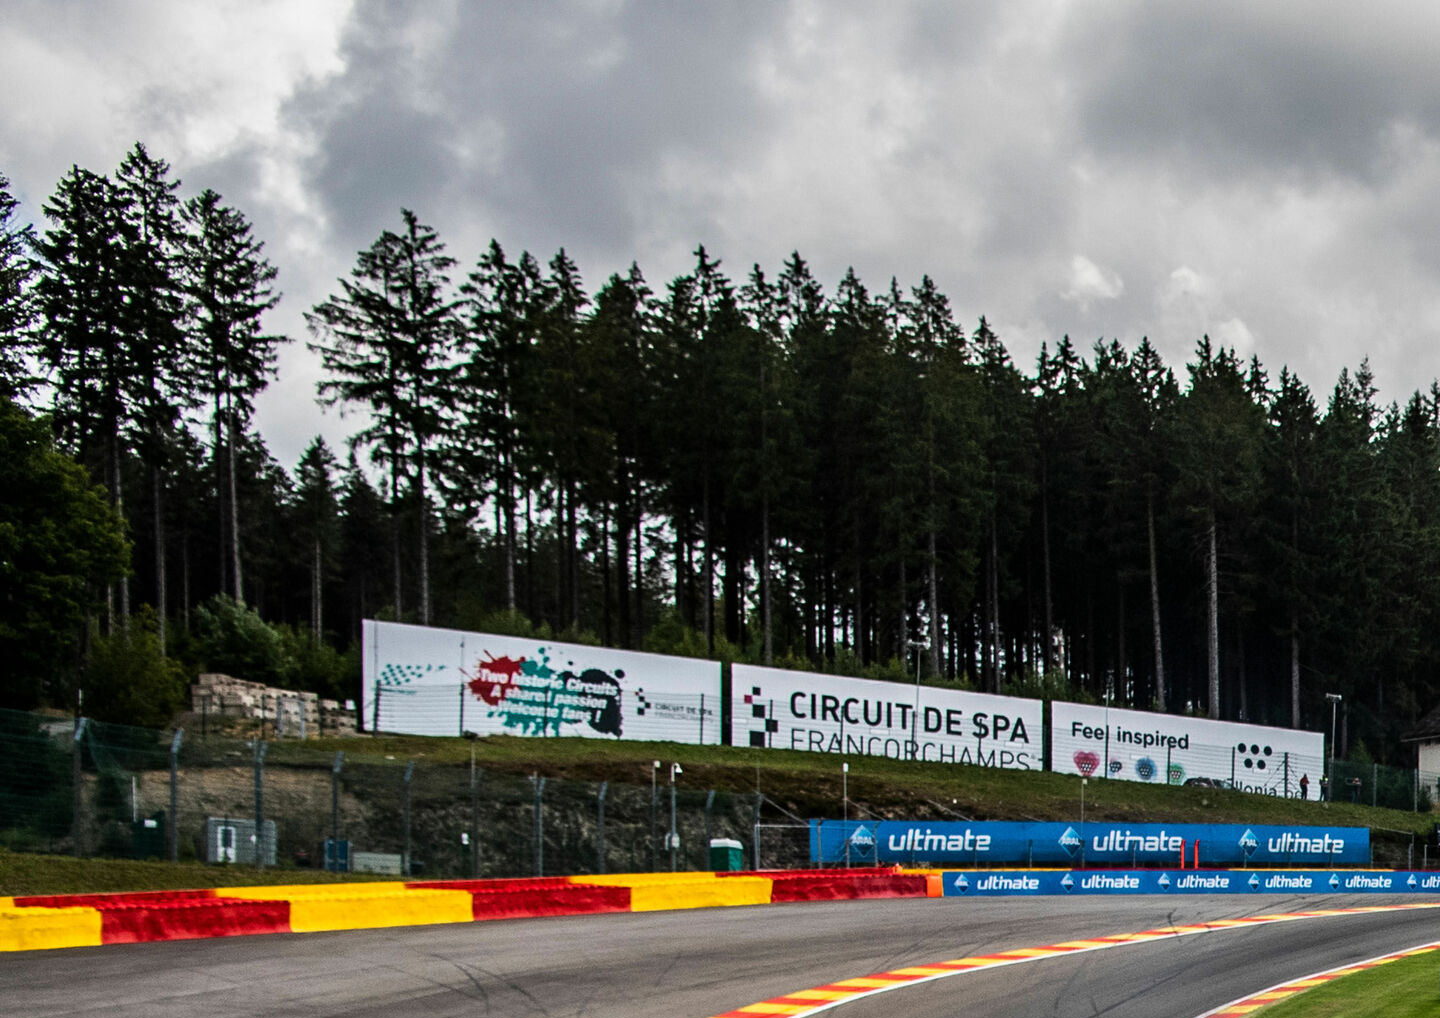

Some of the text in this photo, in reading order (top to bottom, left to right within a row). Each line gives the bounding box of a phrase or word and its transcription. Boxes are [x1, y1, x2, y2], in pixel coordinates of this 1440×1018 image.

[481, 669, 618, 696] Two historic Circuits
[490, 684, 502, 697] A
[554, 694, 608, 709] passion
[790, 691, 1030, 744] CIRCUIT DE SPA
[1117, 726, 1190, 750] inspired
[888, 829, 991, 851] ultimate
[1093, 830, 1183, 852] ultimate
[1268, 832, 1345, 853] ultimate
[977, 875, 1039, 890] ultimate
[1081, 875, 1140, 889] ultimate
[1177, 875, 1230, 889] ultimate
[1265, 875, 1313, 888] ultimate
[1345, 875, 1392, 888] ultimate
